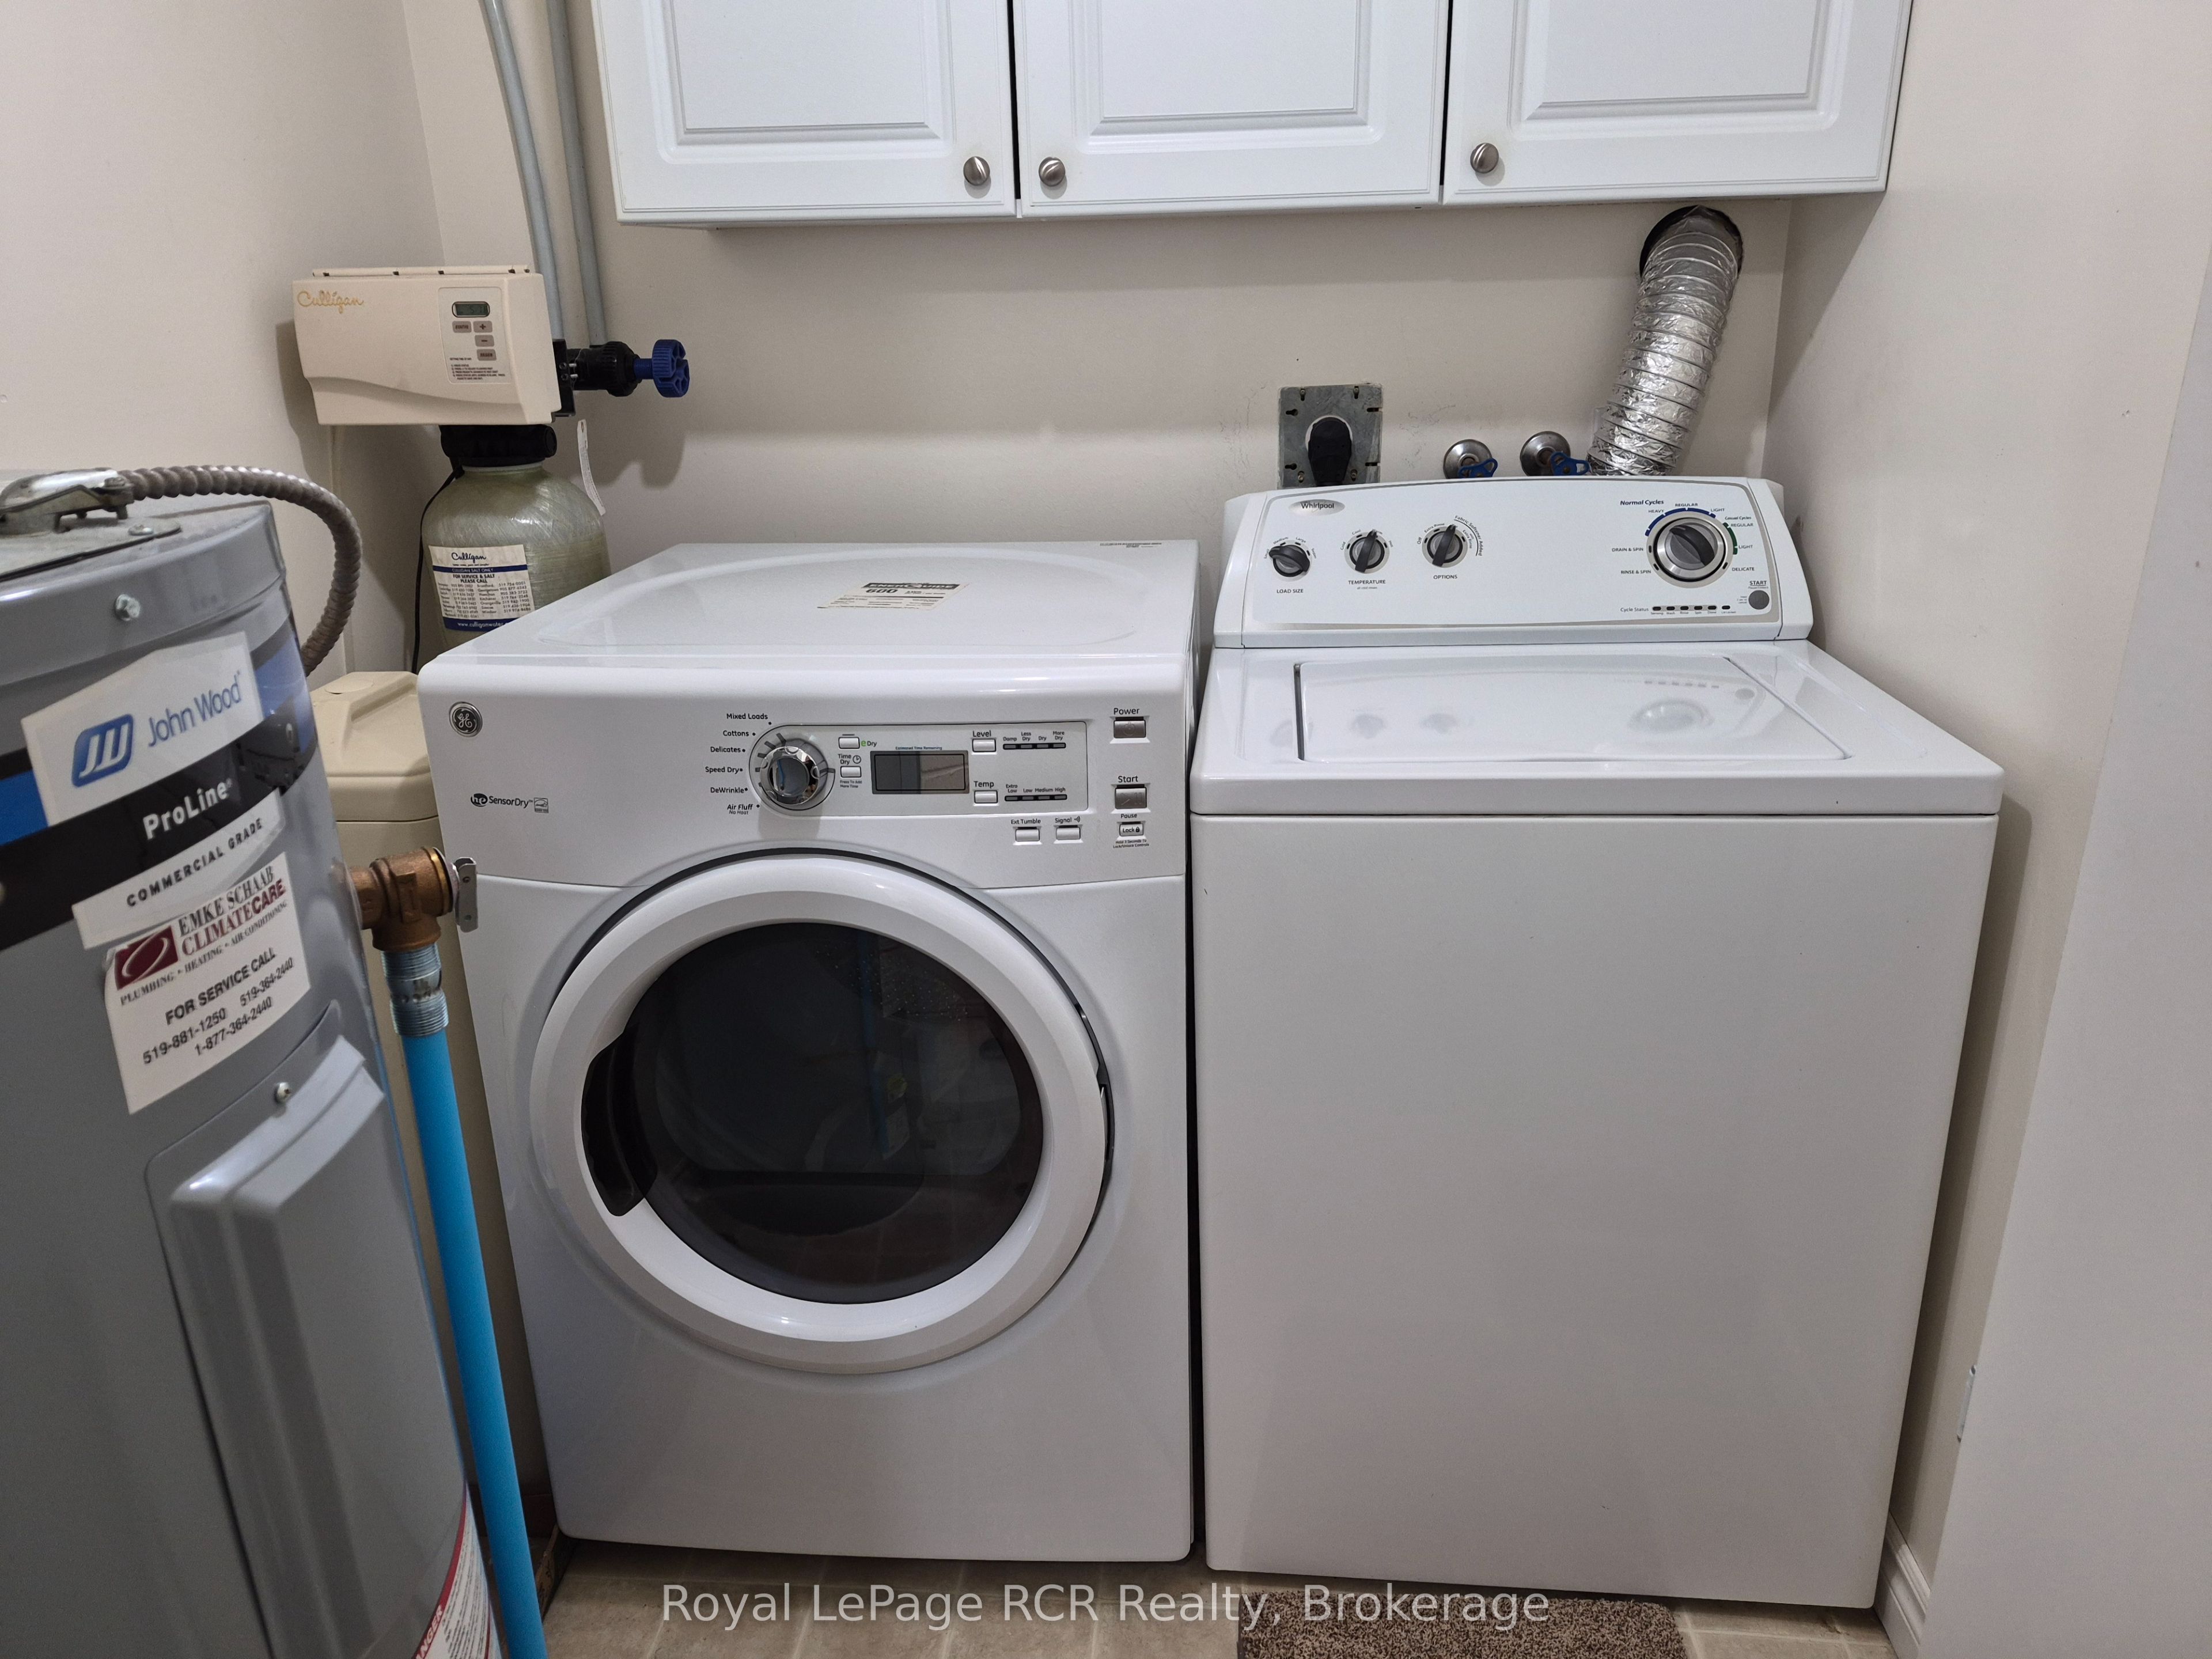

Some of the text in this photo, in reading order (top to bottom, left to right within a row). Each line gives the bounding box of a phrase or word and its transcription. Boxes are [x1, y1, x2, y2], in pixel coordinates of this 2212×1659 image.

[297, 290, 364, 314] Culligan
[1300, 502, 1334, 510] Whirlpool
[1455, 515, 1469, 524] Fabric
[1469, 522, 1482, 540] Softener
[452, 552, 486, 563] Culligan
[148, 680, 241, 747] John Wood
[142, 782, 229, 840] ProLine
[126, 818, 263, 907] COMMERCIAL GRADE
[178, 866, 274, 937] EMKE SCHAAB
[181, 878, 286, 956] CLIMATECARE
[120, 971, 175, 1006] PLUMBING
[184, 946, 222, 972] HEATING
[165, 947, 276, 1025] FOR SERVICE CALL
[143, 957, 293, 1064] 519-881-1250 519-364-2440
[195, 996, 272, 1056] 1-877-364-2440
